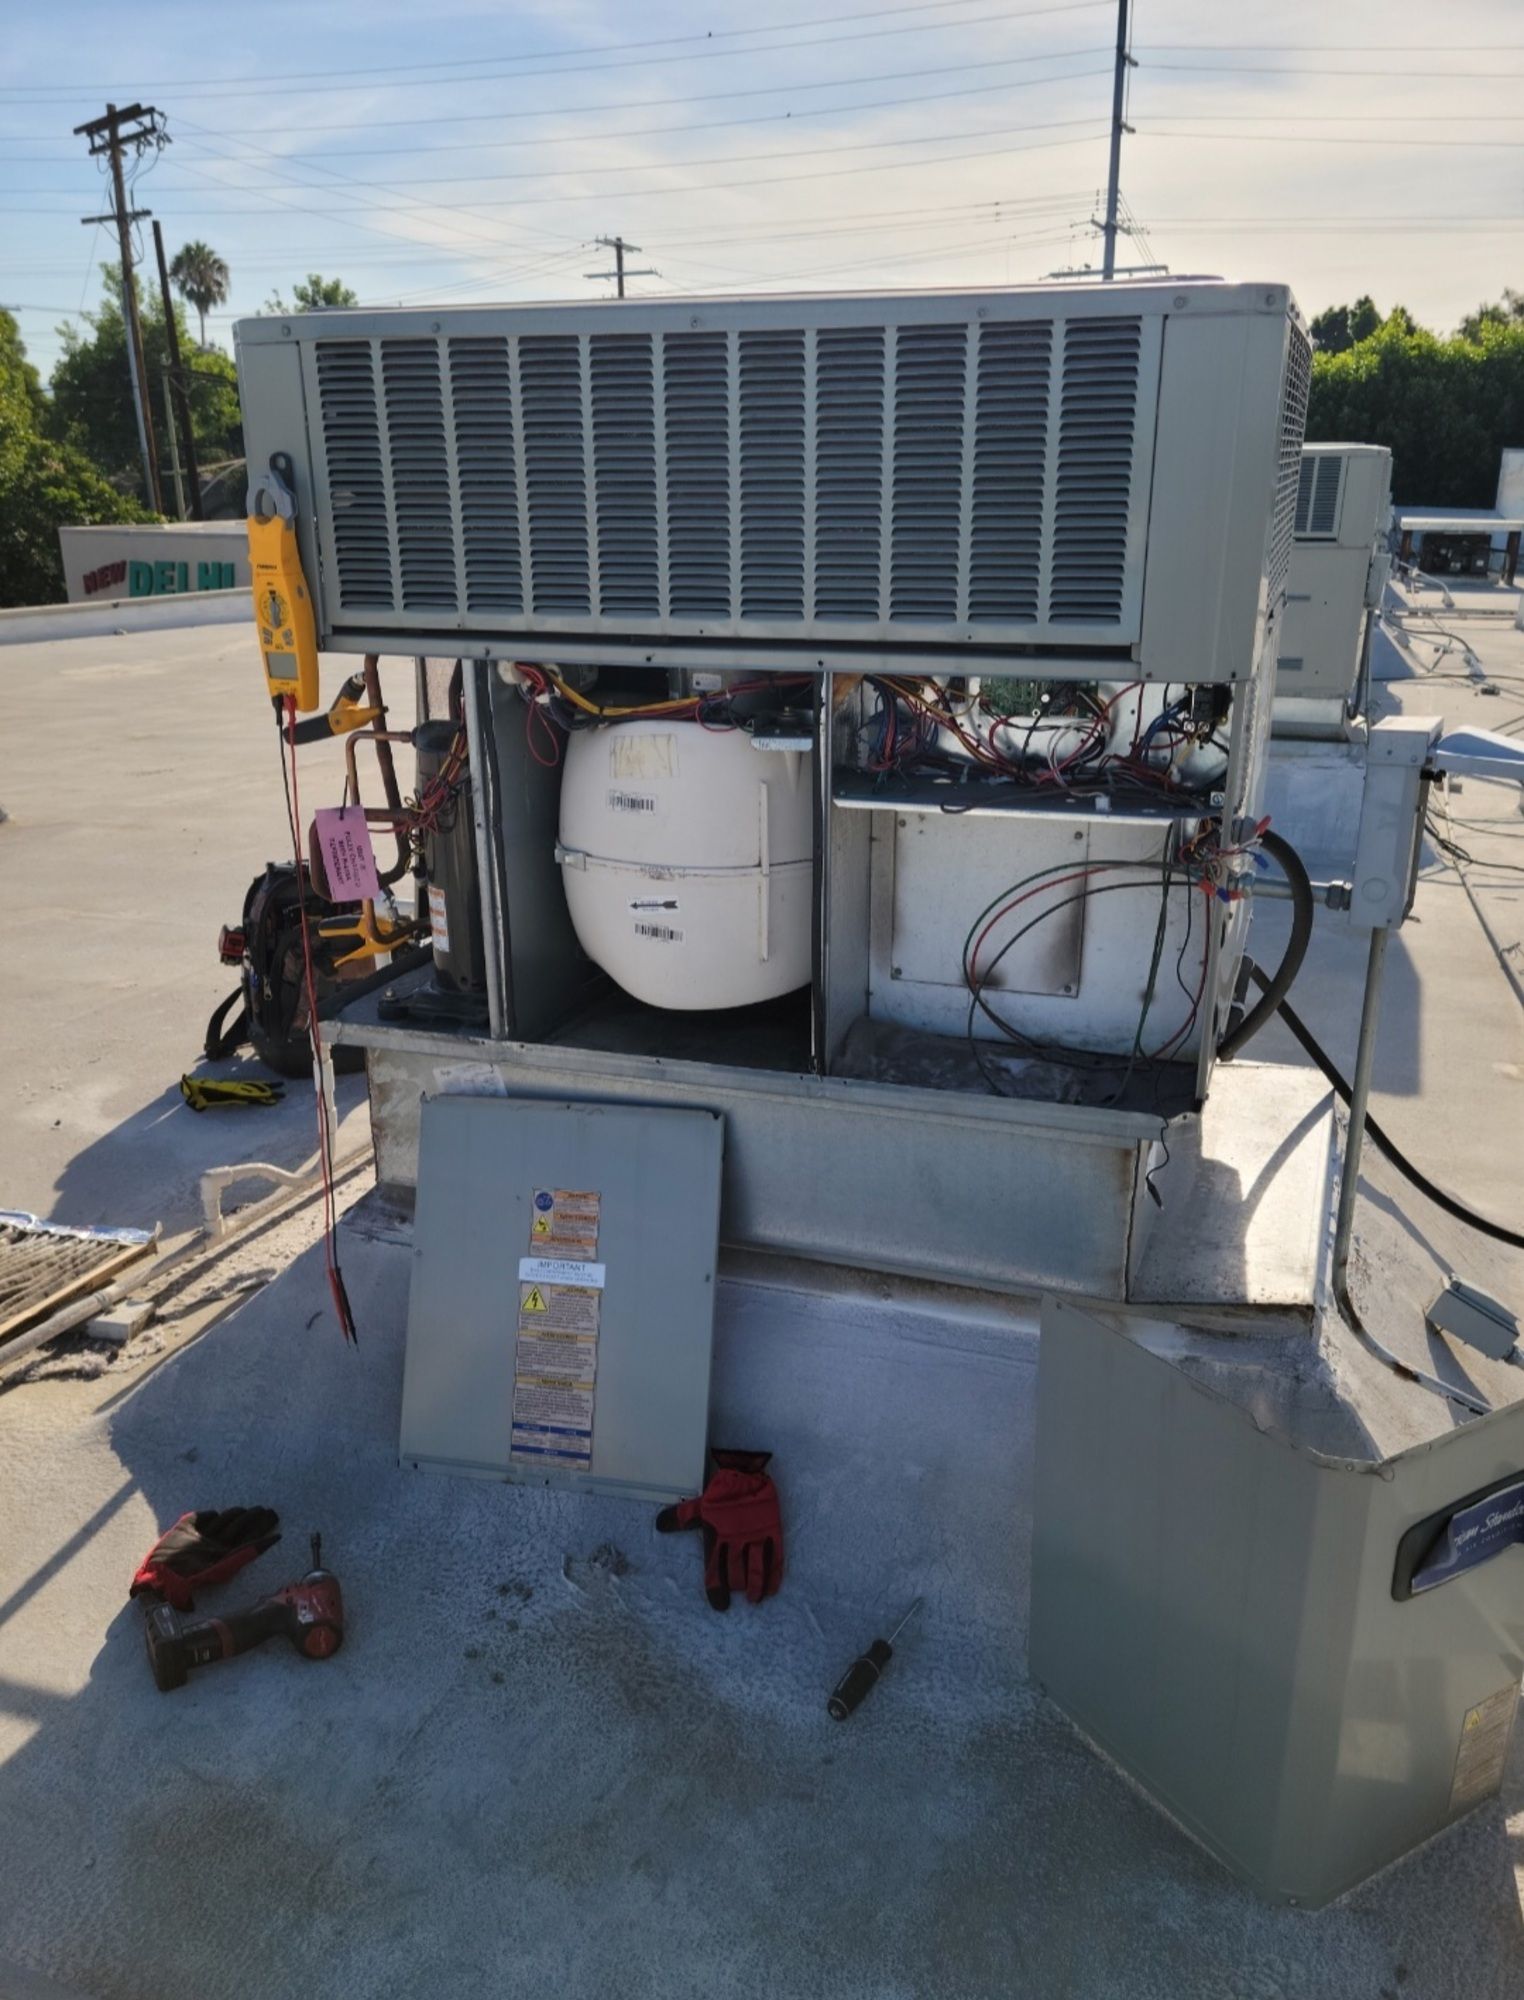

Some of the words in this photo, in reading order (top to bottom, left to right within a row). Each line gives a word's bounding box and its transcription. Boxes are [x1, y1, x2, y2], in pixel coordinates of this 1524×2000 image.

[83, 559, 127, 595] NEW
[129, 560, 236, 597] DELHI
[537, 1260, 586, 1272] IMPORTANT
